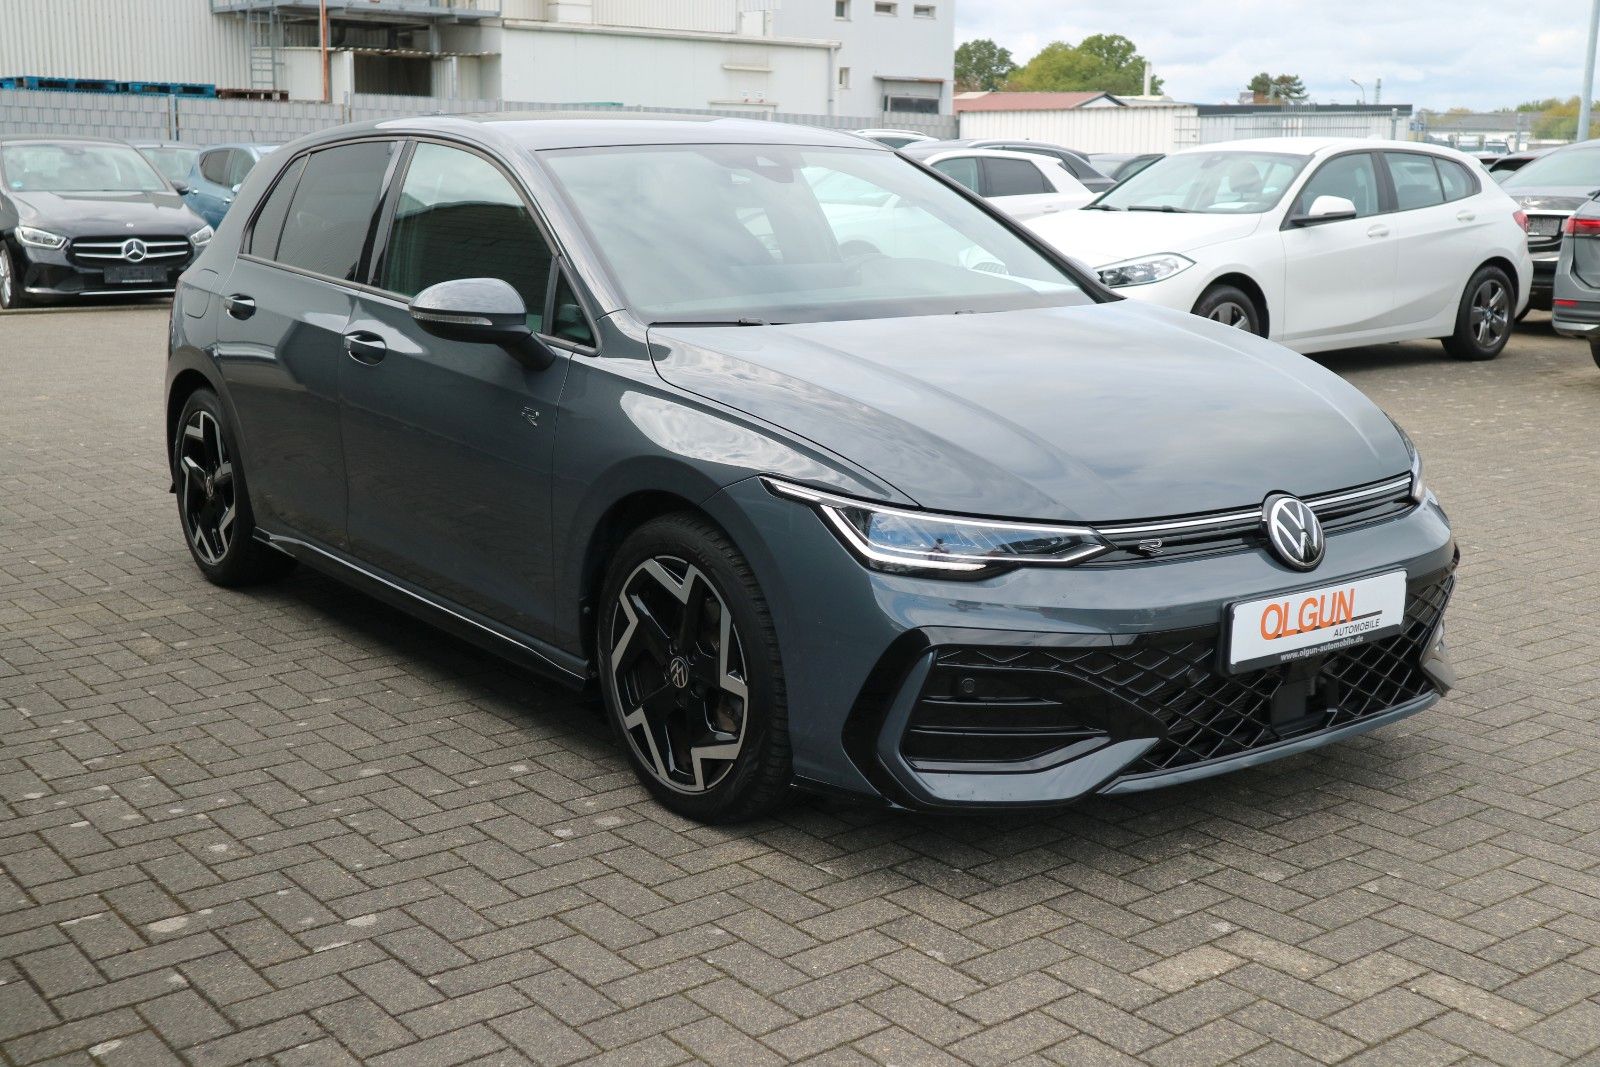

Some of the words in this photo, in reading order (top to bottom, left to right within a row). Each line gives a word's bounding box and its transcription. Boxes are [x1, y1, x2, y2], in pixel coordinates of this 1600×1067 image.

[1260, 588, 1355, 640] OLGUN
[1333, 618, 1381, 638] AUTOMOBILE
[1280, 635, 1364, 662] www.olgun-automobile.de
